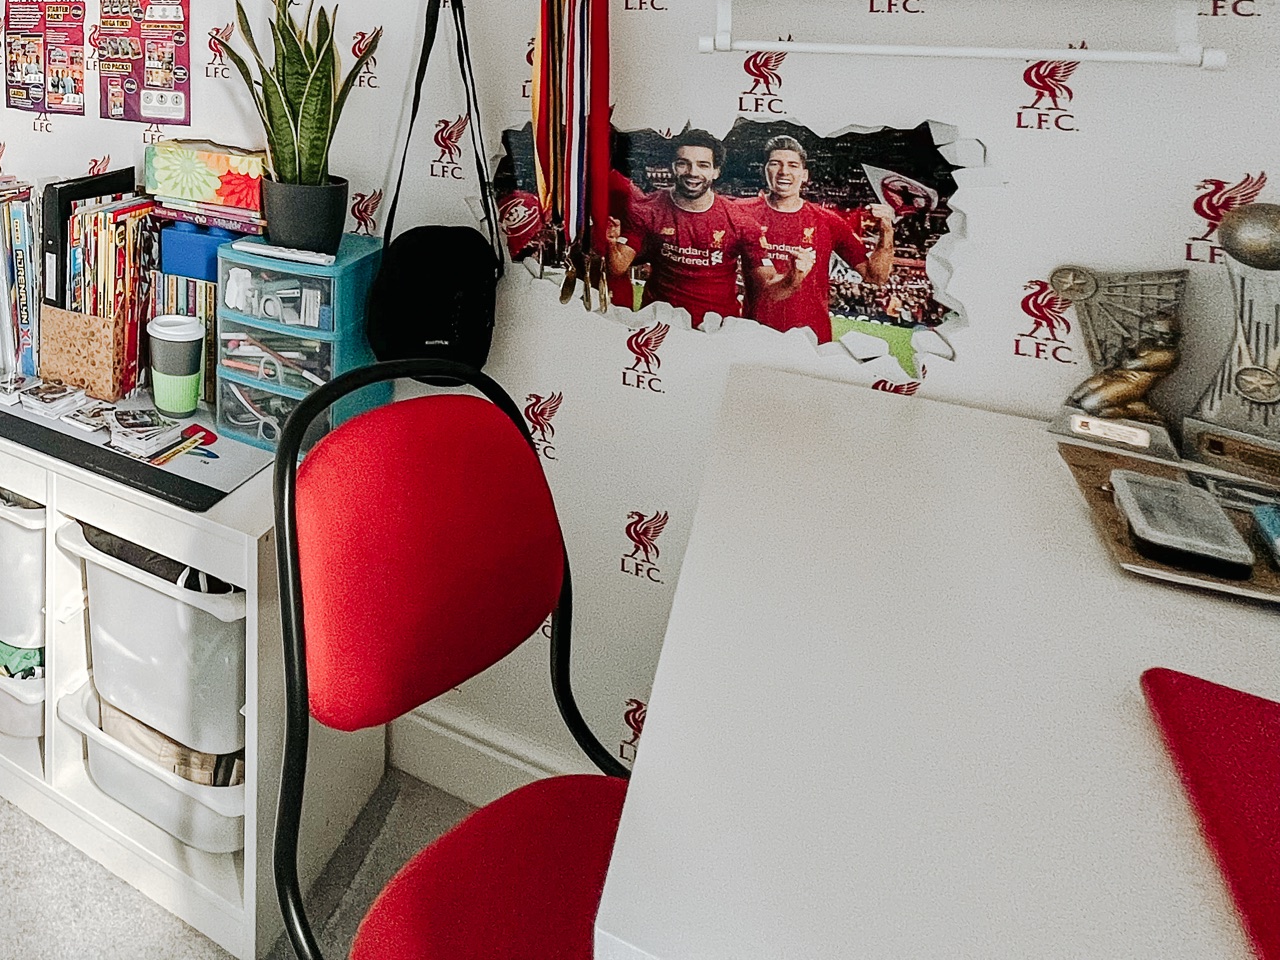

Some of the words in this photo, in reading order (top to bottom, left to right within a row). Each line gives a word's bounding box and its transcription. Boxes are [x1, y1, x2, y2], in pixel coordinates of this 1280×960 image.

[46, 5, 69, 13] STARTER
[661, 249, 709, 267] Chartered
[662, 242, 709, 258] Standard
[14, 249, 30, 325] ADRENALYN
[20, 327, 33, 355] XL
